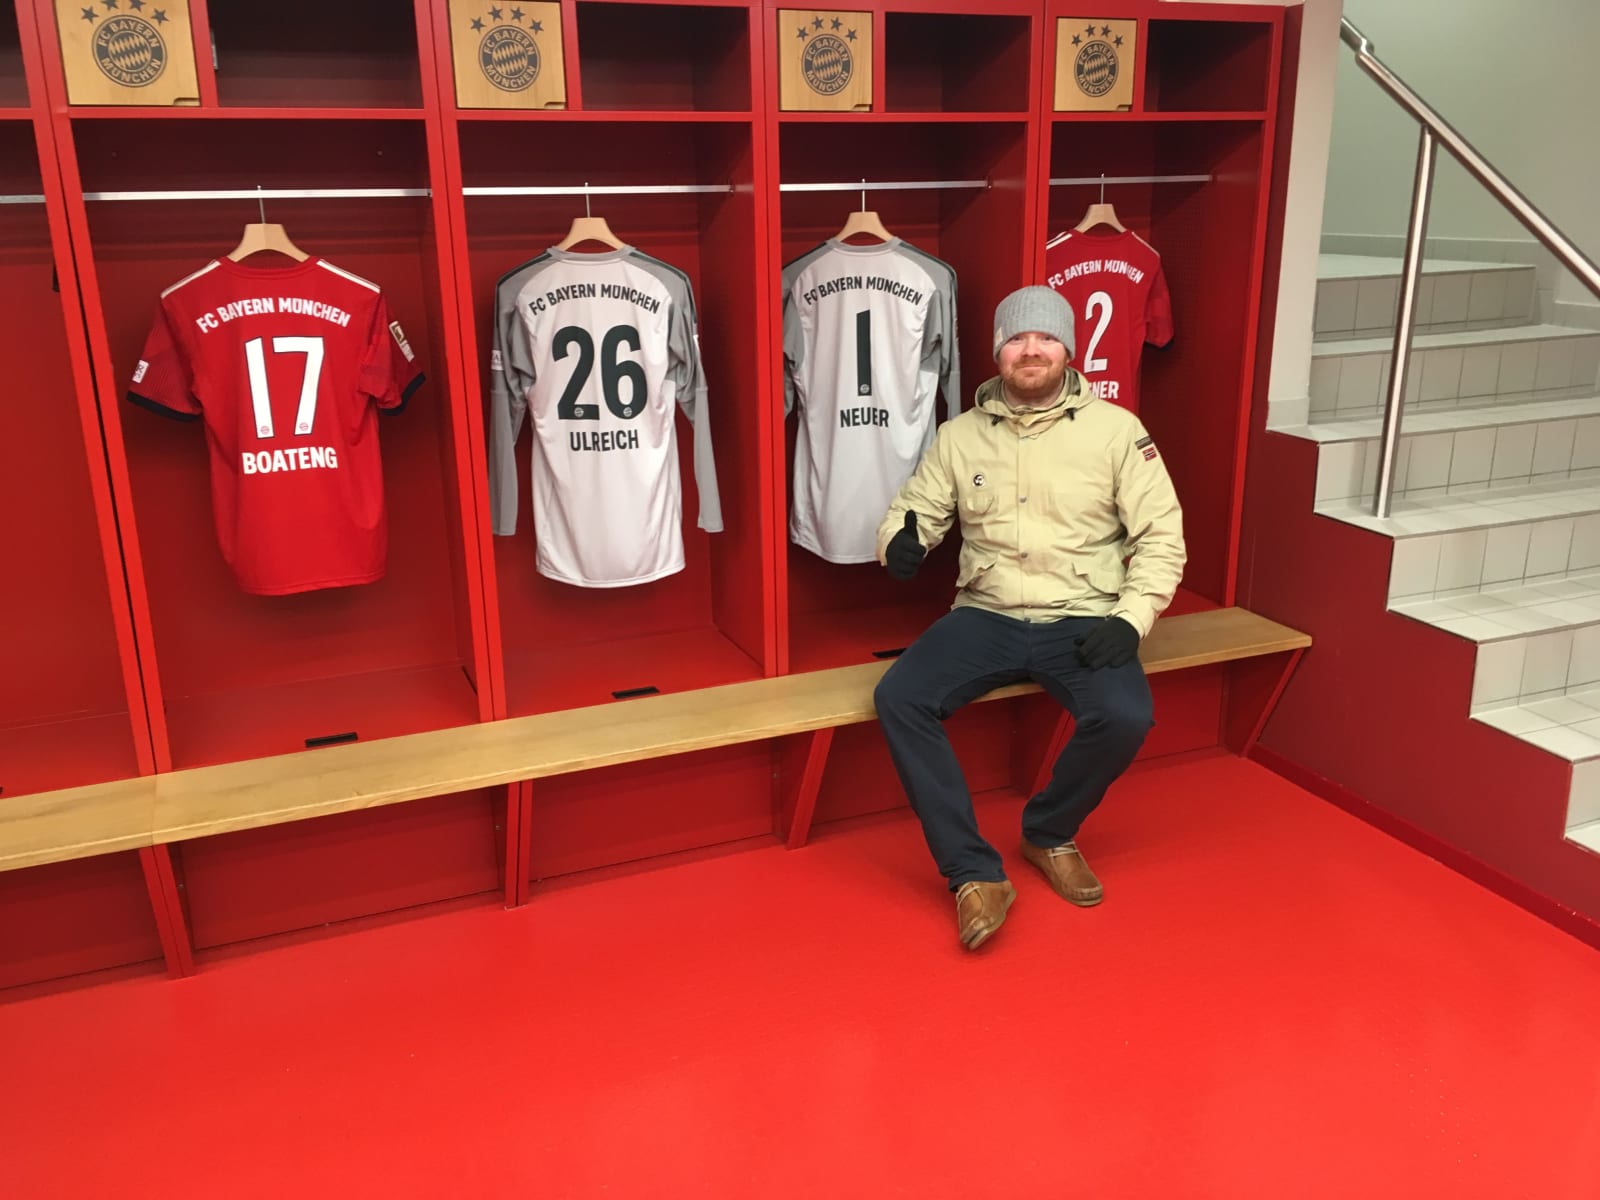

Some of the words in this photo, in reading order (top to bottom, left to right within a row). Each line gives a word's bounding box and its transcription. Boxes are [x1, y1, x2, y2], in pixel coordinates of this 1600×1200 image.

[98, 29, 111, 47] FC
[111, 20, 160, 48] BAYERN
[483, 40, 495, 54] FC
[494, 30, 535, 55] BAYERN
[806, 46, 816, 61] FC
[815, 39, 849, 62] BAYERN
[1047, 273, 1064, 290] FC
[1064, 259, 1102, 281] BAYERN
[1104, 259, 1144, 284] MÜNEN
[528, 297, 546, 316] FC
[547, 283, 596, 306] BAYERN
[600, 283, 660, 315] MÜNCHEN
[804, 289, 818, 305] FC
[818, 275, 862, 298] BAYERN
[866, 275, 923, 306] MÜNCHEN
[196, 313, 219, 333] FC
[216, 297, 275, 322] BAYERN
[278, 297, 351, 328] MÜNCHEN
[1083, 291, 1113, 373] 2
[856, 309, 872, 396] 1
[244, 336, 325, 439] 17
[552, 324, 648, 420] 26
[840, 406, 889, 428] NEUER
[569, 429, 639, 452] ULREICH
[242, 446, 338, 475] BOATENG
